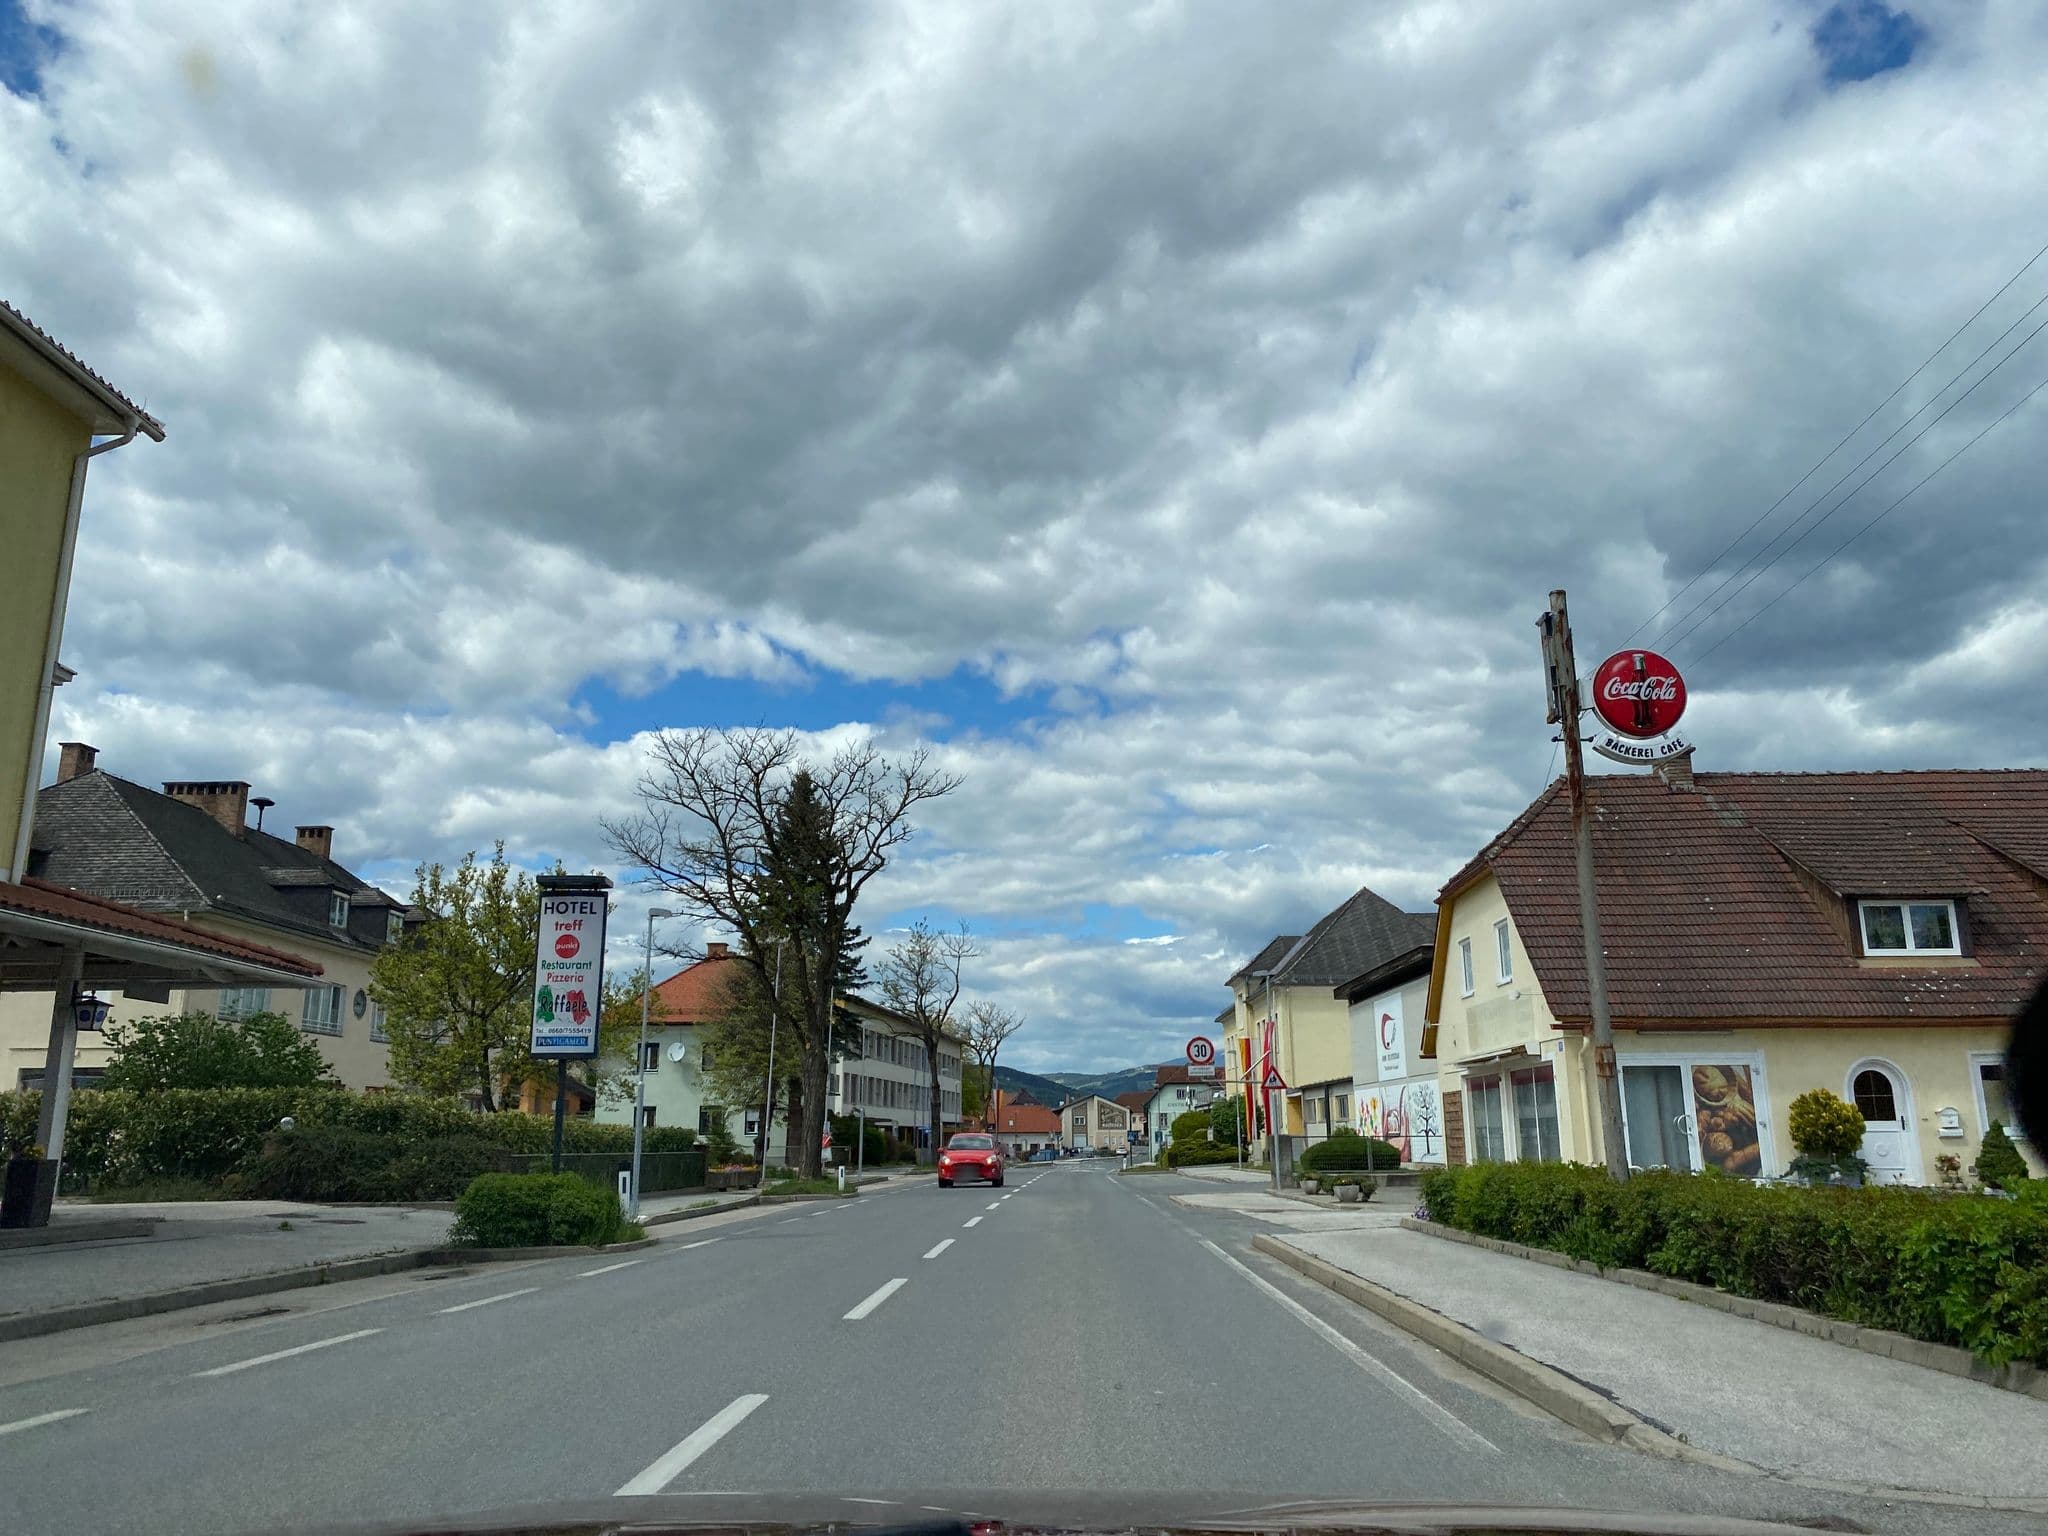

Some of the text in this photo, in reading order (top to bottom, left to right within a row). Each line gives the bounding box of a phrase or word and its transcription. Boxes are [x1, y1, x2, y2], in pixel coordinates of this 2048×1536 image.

[1603, 676, 1677, 701] Coca-Cola
[543, 901, 597, 915] HOTEL
[554, 919, 584, 932] treff
[555, 942, 578, 951] punkt
[541, 959, 593, 970] Restaurant
[546, 972, 584, 983] Pizzeria
[541, 994, 588, 1013] Raffaele
[1194, 1044, 1207, 1057] 30
